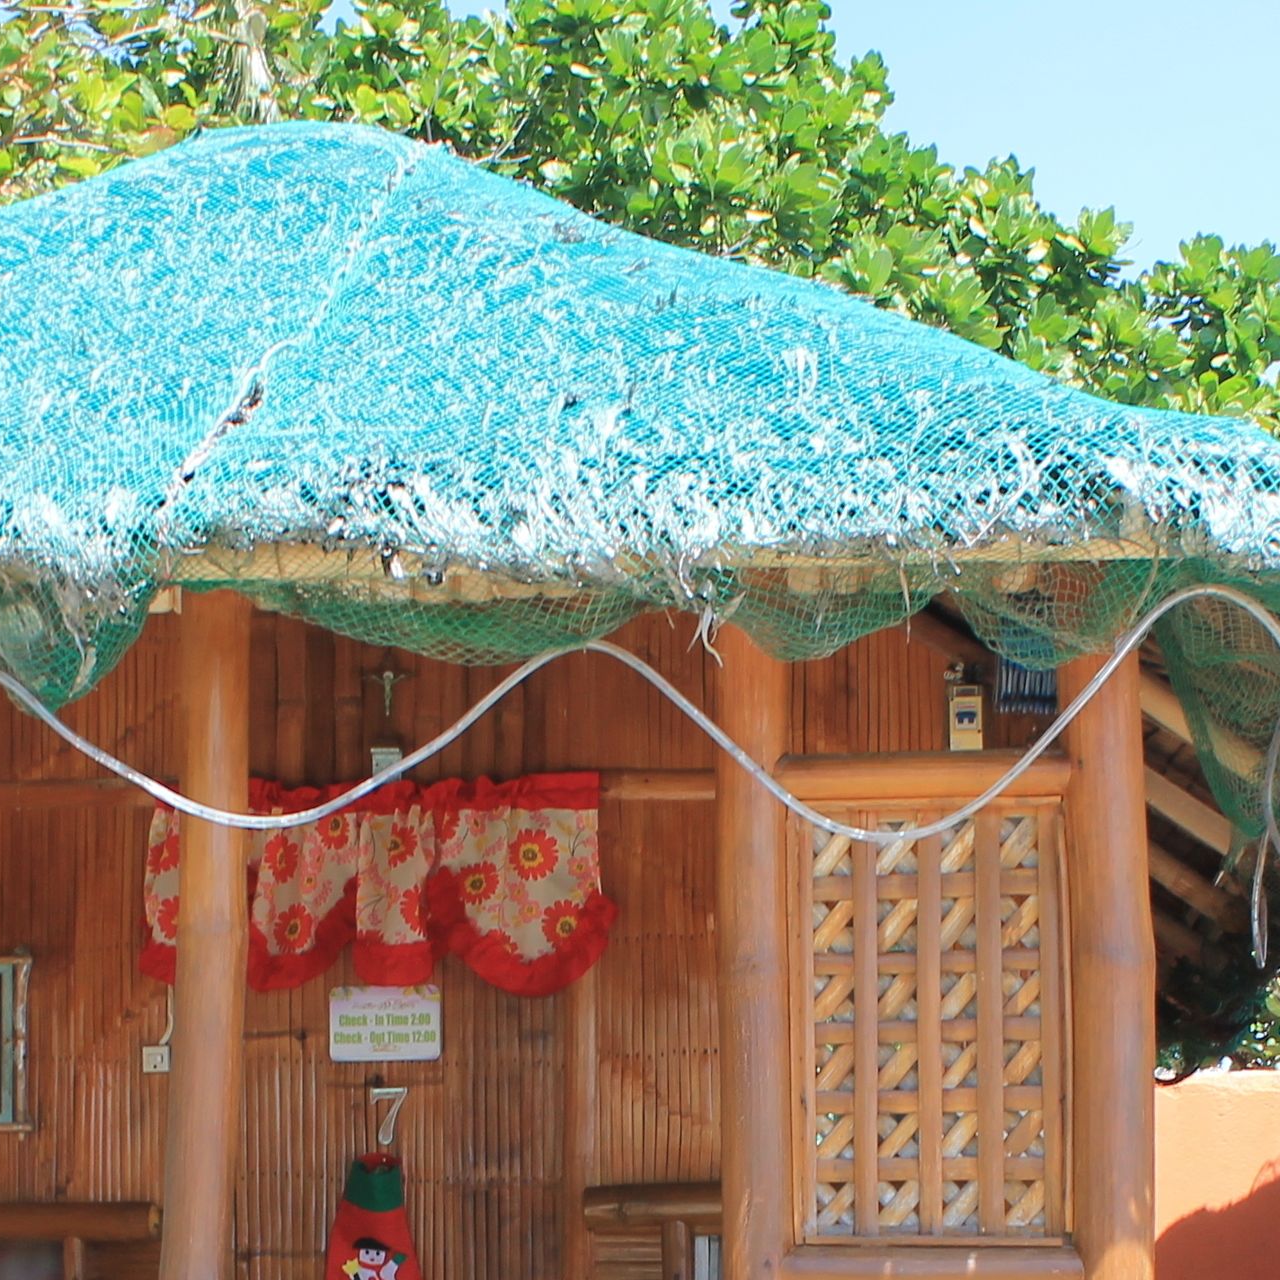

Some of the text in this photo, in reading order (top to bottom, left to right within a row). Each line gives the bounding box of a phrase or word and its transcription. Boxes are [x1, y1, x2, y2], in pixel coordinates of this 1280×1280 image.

[339, 1014, 367, 1026] Check
[375, 1014, 384, 1026] In
[386, 1013, 409, 1026] Time
[411, 1013, 431, 1025] 2:00
[334, 1032, 362, 1044] Check
[387, 1031, 409, 1044] Time
[412, 1031, 436, 1043] 12:00
[370, 1087, 408, 1145] 7
